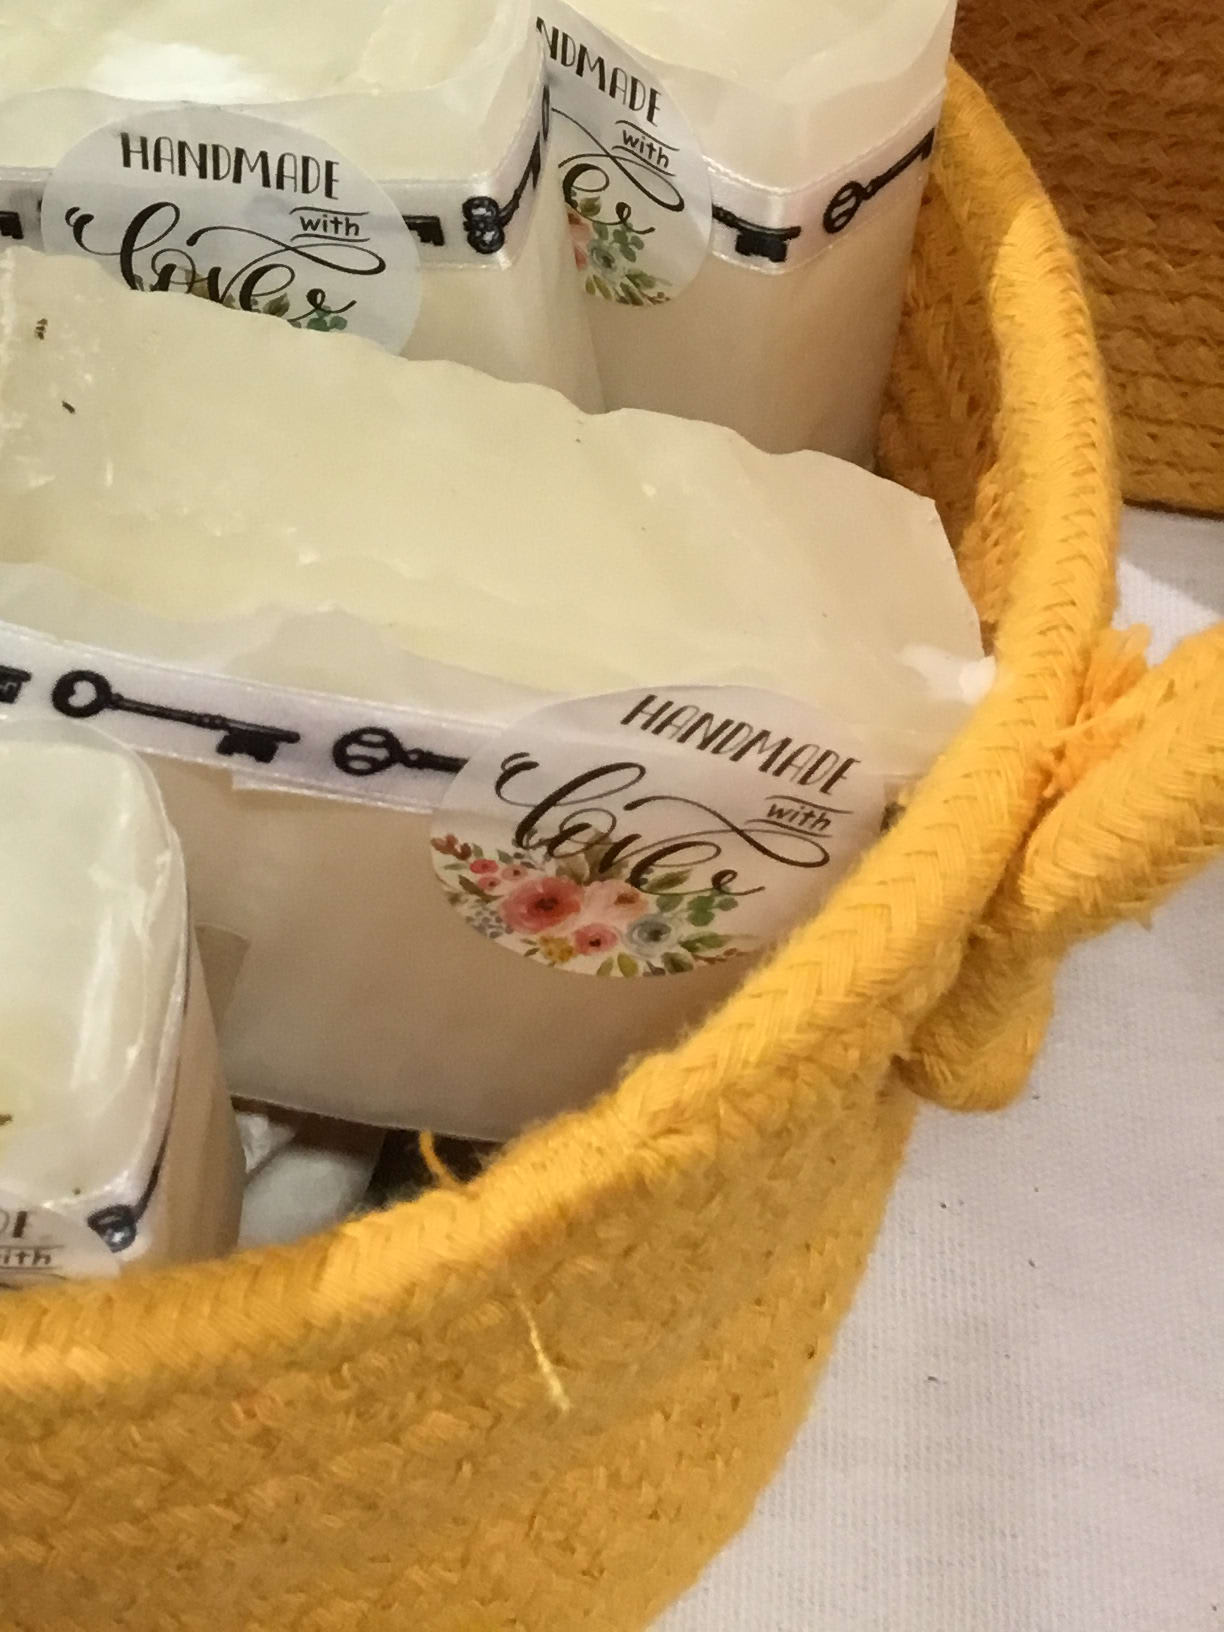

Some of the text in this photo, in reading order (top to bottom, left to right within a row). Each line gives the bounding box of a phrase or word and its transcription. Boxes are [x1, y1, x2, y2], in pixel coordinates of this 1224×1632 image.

[536, 16, 662, 128] NDMADE
[120, 131, 340, 201] HANDMADE
[622, 129, 670, 169] with
[299, 214, 361, 237] with
[620, 694, 862, 796] HANDMADE
[765, 801, 832, 831] with
